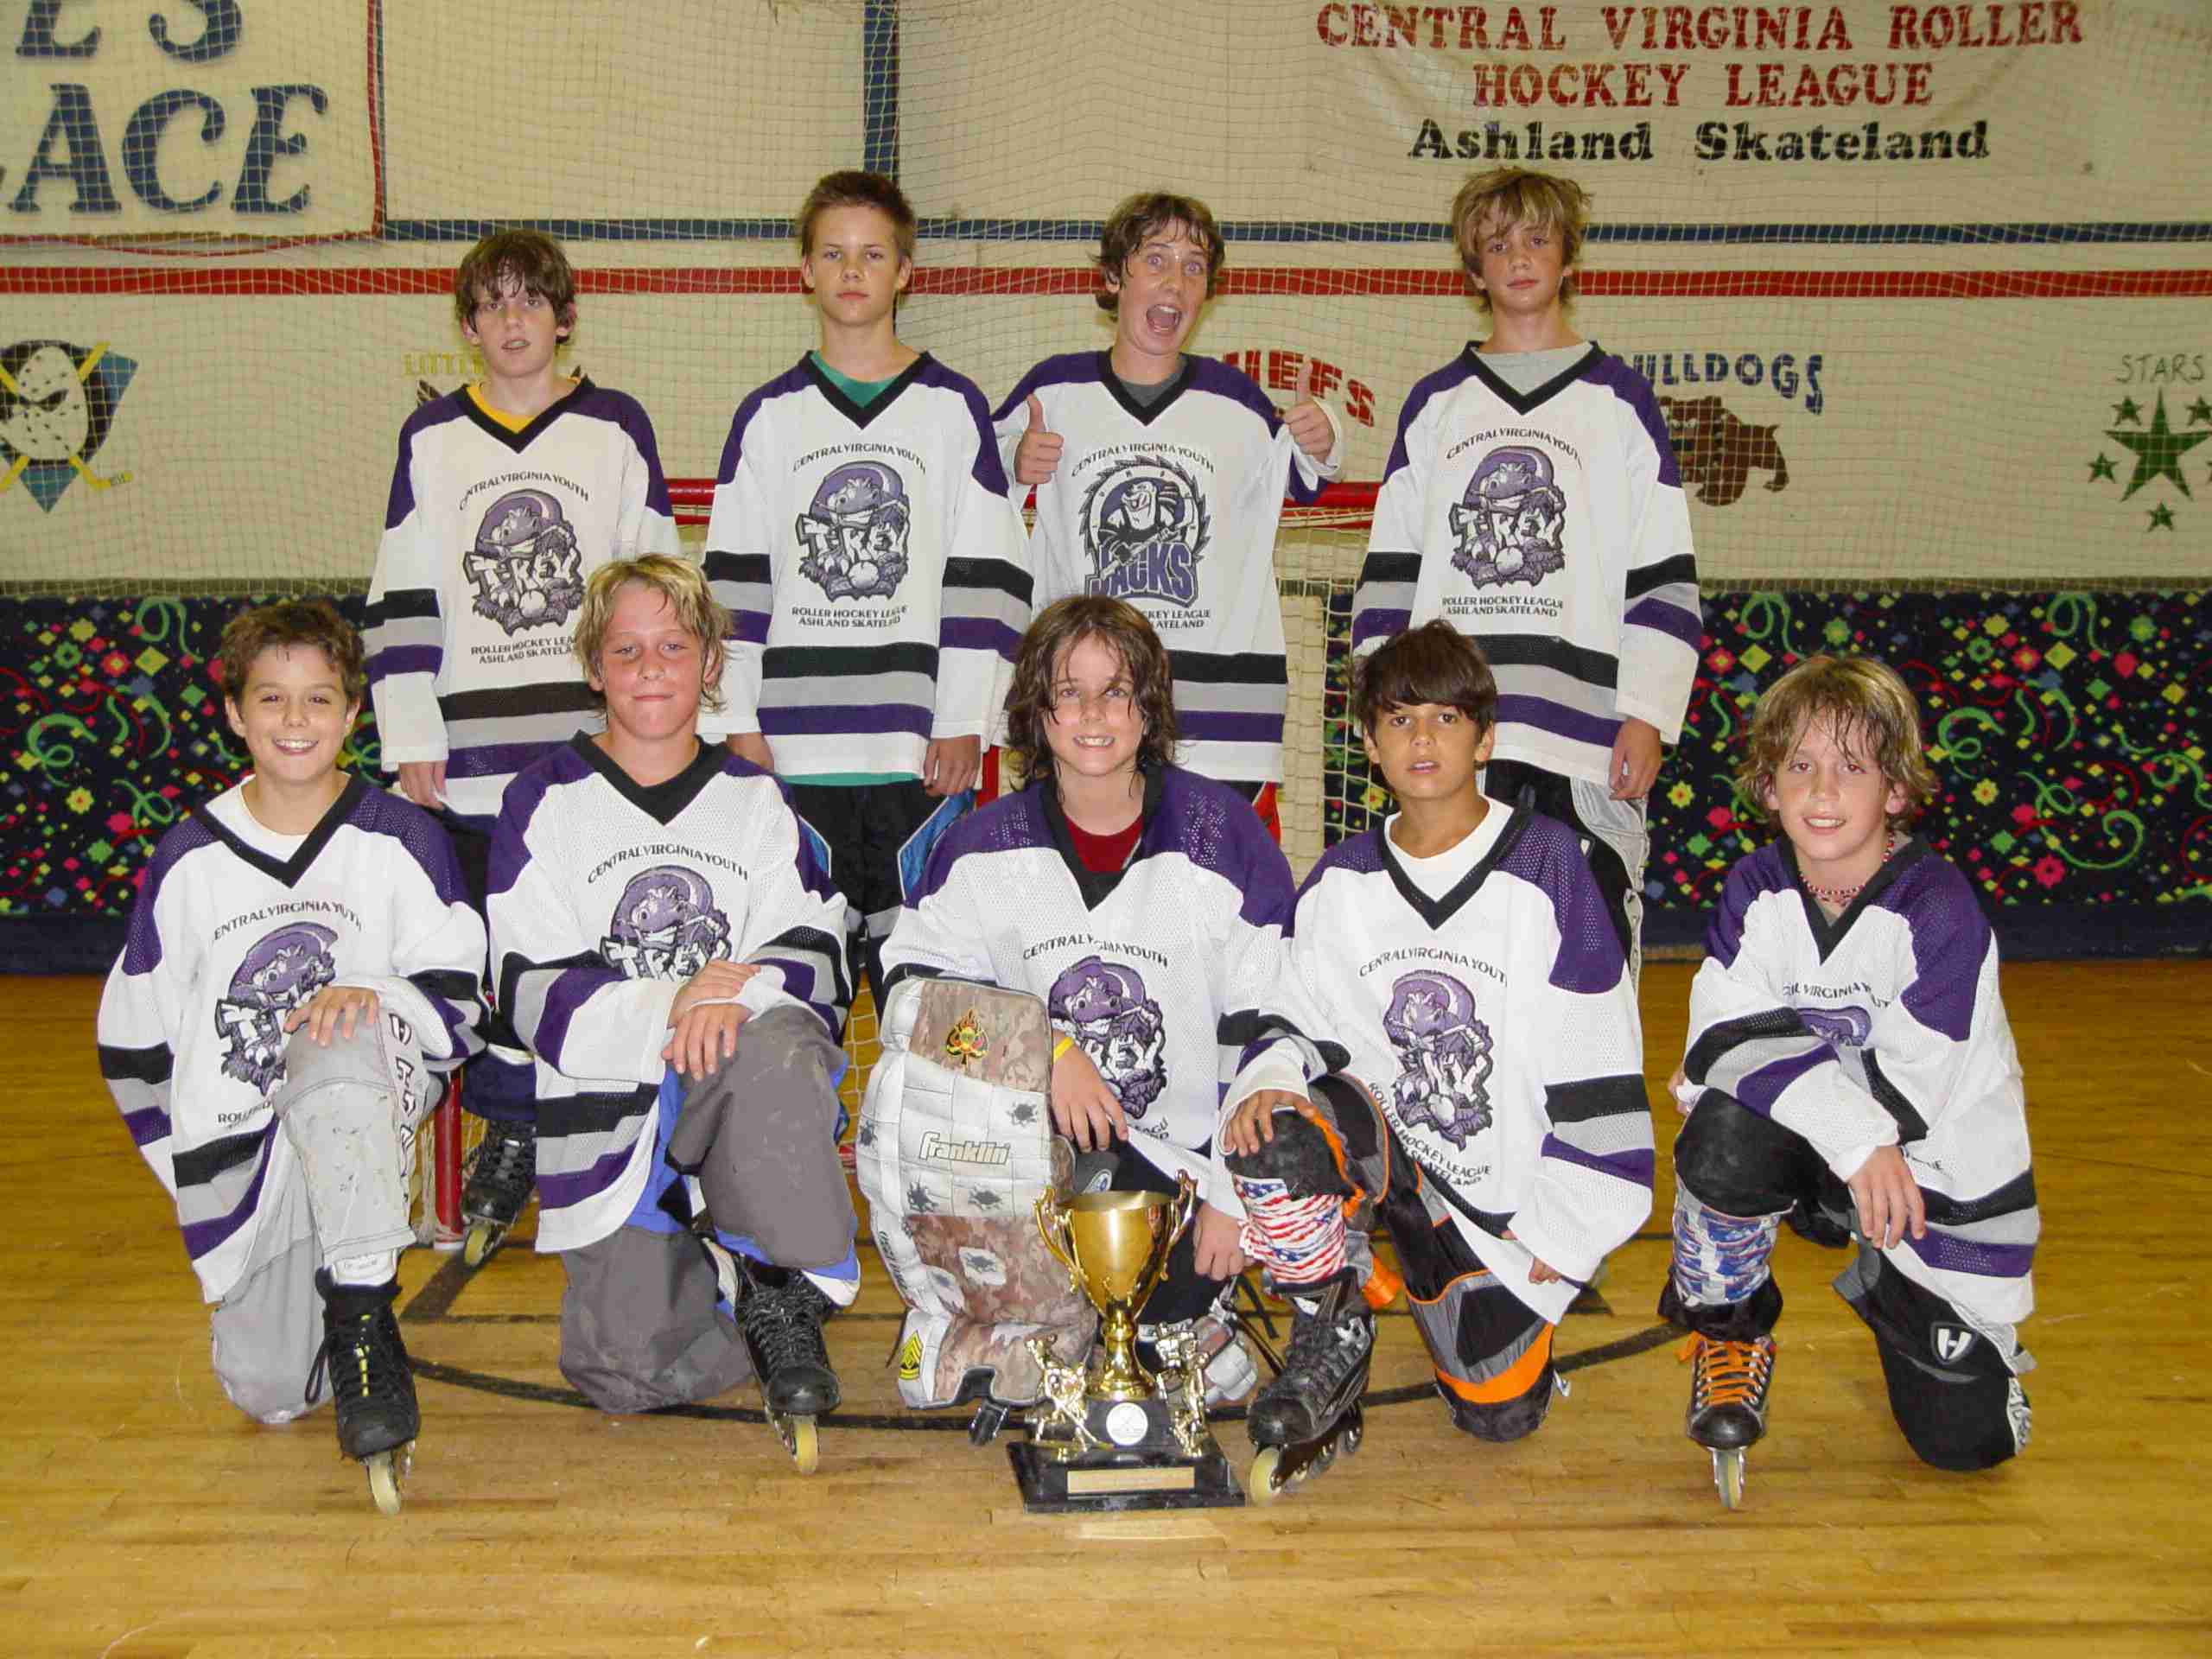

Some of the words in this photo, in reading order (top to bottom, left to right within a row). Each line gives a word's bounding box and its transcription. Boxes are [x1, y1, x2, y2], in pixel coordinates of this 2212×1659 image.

[1316, 3, 1567, 50] CENTRAL
[1601, 6, 1852, 51] VIRGINIA
[1886, 1, 2082, 49] ROLLER
[1472, 63, 1691, 107] HOCKEY
[1725, 61, 1935, 107] LEAGUE
[0, 84, 328, 213] ACE
[1408, 118, 1654, 161] Ashland
[1694, 119, 1991, 162] Skateland
[1633, 353, 1823, 416] ULLDOGS
[2115, 353, 2205, 385] STARS
[1224, 349, 1376, 428] IEFS
[793, 443, 842, 473] CENTRAL
[843, 442, 895, 455] VIRGINIA
[1121, 442, 1176, 454] VIRGINIA
[1177, 447, 1215, 474] YOUTH
[1446, 429, 1497, 459] CENTRAL
[1498, 428, 1552, 443] VIRGINIA
[500, 471, 552, 483] VIRGINIA
[553, 474, 589, 502] YOUTH
[791, 607, 831, 618] ROLLER
[833, 608, 879, 619] HOCKEY
[1442, 595, 1478, 606] ROLLER
[1479, 594, 1521, 606] HOCKEY
[1446, 606, 1494, 615] ASHLAND
[1495, 605, 1558, 618] SKATELAND
[798, 616, 849, 628] ASHLAND
[1156, 620, 1205, 629] ATELAND
[471, 644, 512, 656] ROLLER
[512, 637, 552, 651] HOCKEY
[479, 652, 524, 664] ASHLAND
[525, 646, 572, 658] SKATELA
[588, 843, 641, 884] CENTRAL
[642, 842, 703, 862] VIRGINIA
[704, 851, 749, 881] YOUTH
[213, 909, 268, 942] ENTRAL
[268, 899, 331, 917] VIRGINIA
[1023, 933, 1086, 960] CENTRAL
[1122, 942, 1167, 968] YOUTH
[1408, 946, 1469, 967] VIRGINIA
[1803, 982, 1861, 999] VIRGINIA
[1399, 1129, 1446, 1163] HOCKEY
[1446, 1160, 1491, 1178] LEAGUE
